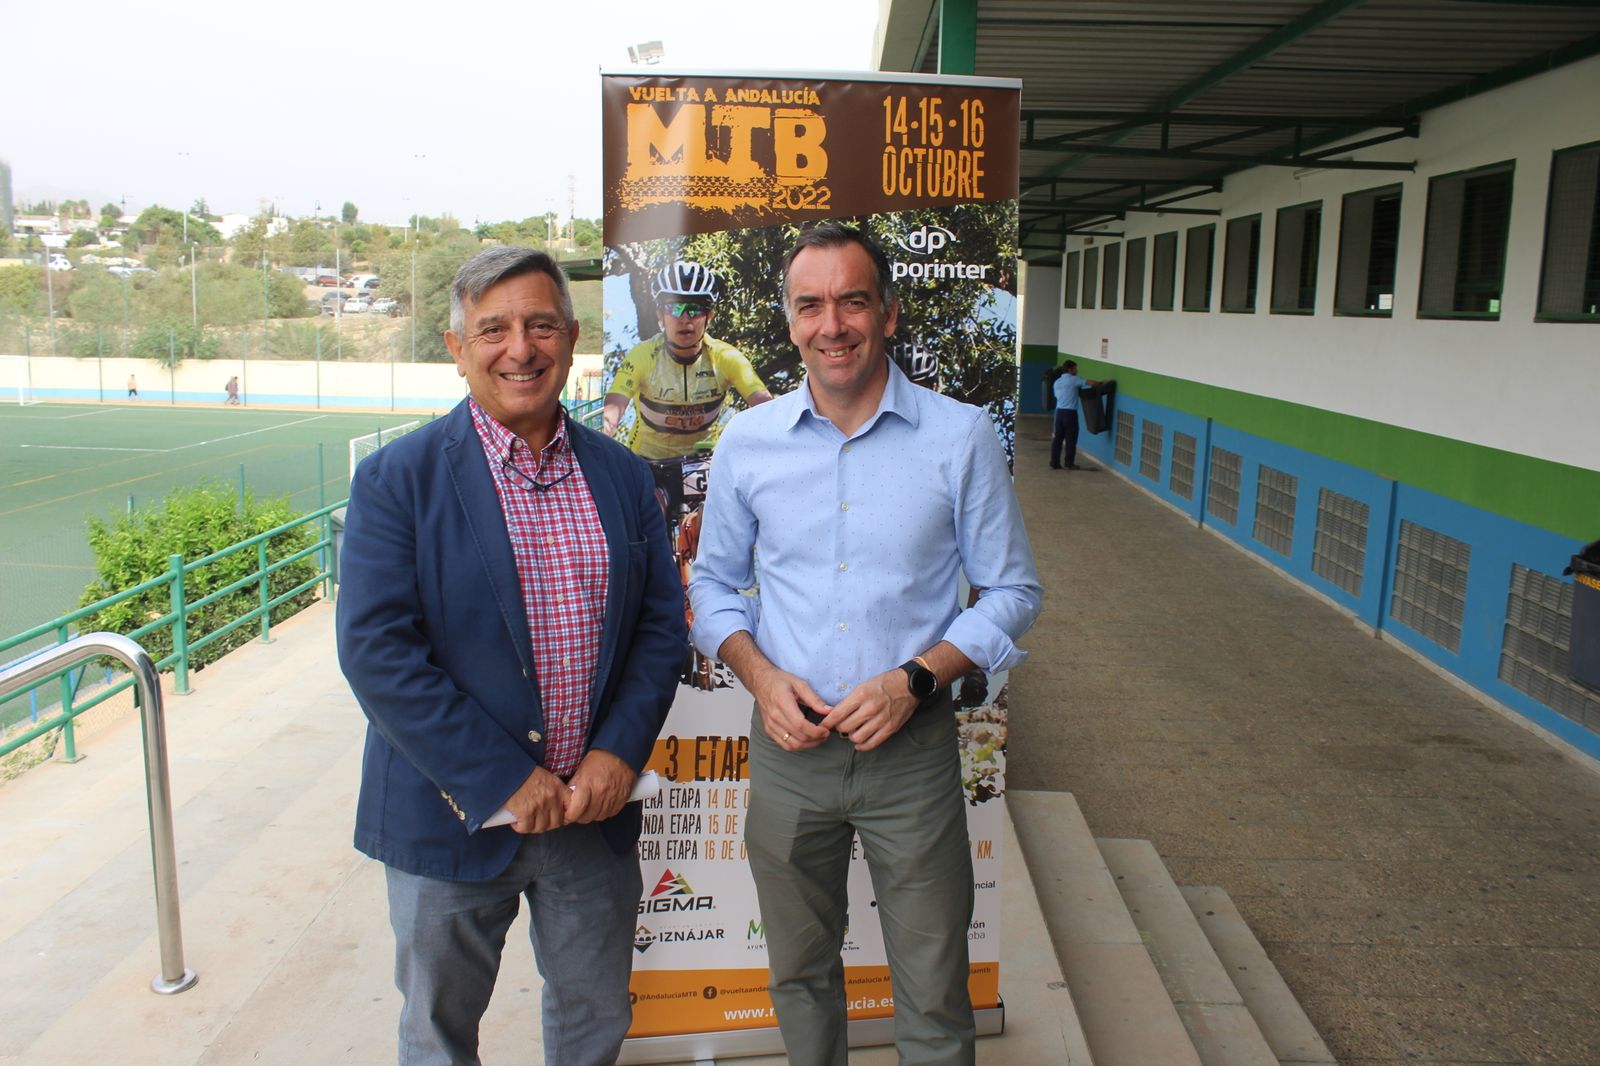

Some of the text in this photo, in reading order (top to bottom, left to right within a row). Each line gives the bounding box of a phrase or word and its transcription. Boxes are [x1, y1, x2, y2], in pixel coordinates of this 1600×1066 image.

[628, 86, 821, 106] VUELTA A ANDALUCÍA
[623, 103, 829, 190] MTB
[882, 145, 985, 199] OCTUBRE
[771, 184, 831, 210] 2022
[888, 258, 988, 282] porinter
[664, 735, 750, 783] 3 ETAP
[641, 788, 664, 810] ERA
[669, 788, 701, 810] ETAPA
[706, 788, 719, 810] 14
[724, 788, 739, 810] DE
[670, 814, 702, 835] ETAPA
[708, 814, 719, 835] 15
[724, 814, 739, 835] DE
[666, 840, 698, 861] ETAPA
[703, 840, 716, 861] 16
[721, 840, 735, 861] DE
[637, 896, 714, 914] SIGMA
[659, 927, 726, 943] IZNÁJAR
